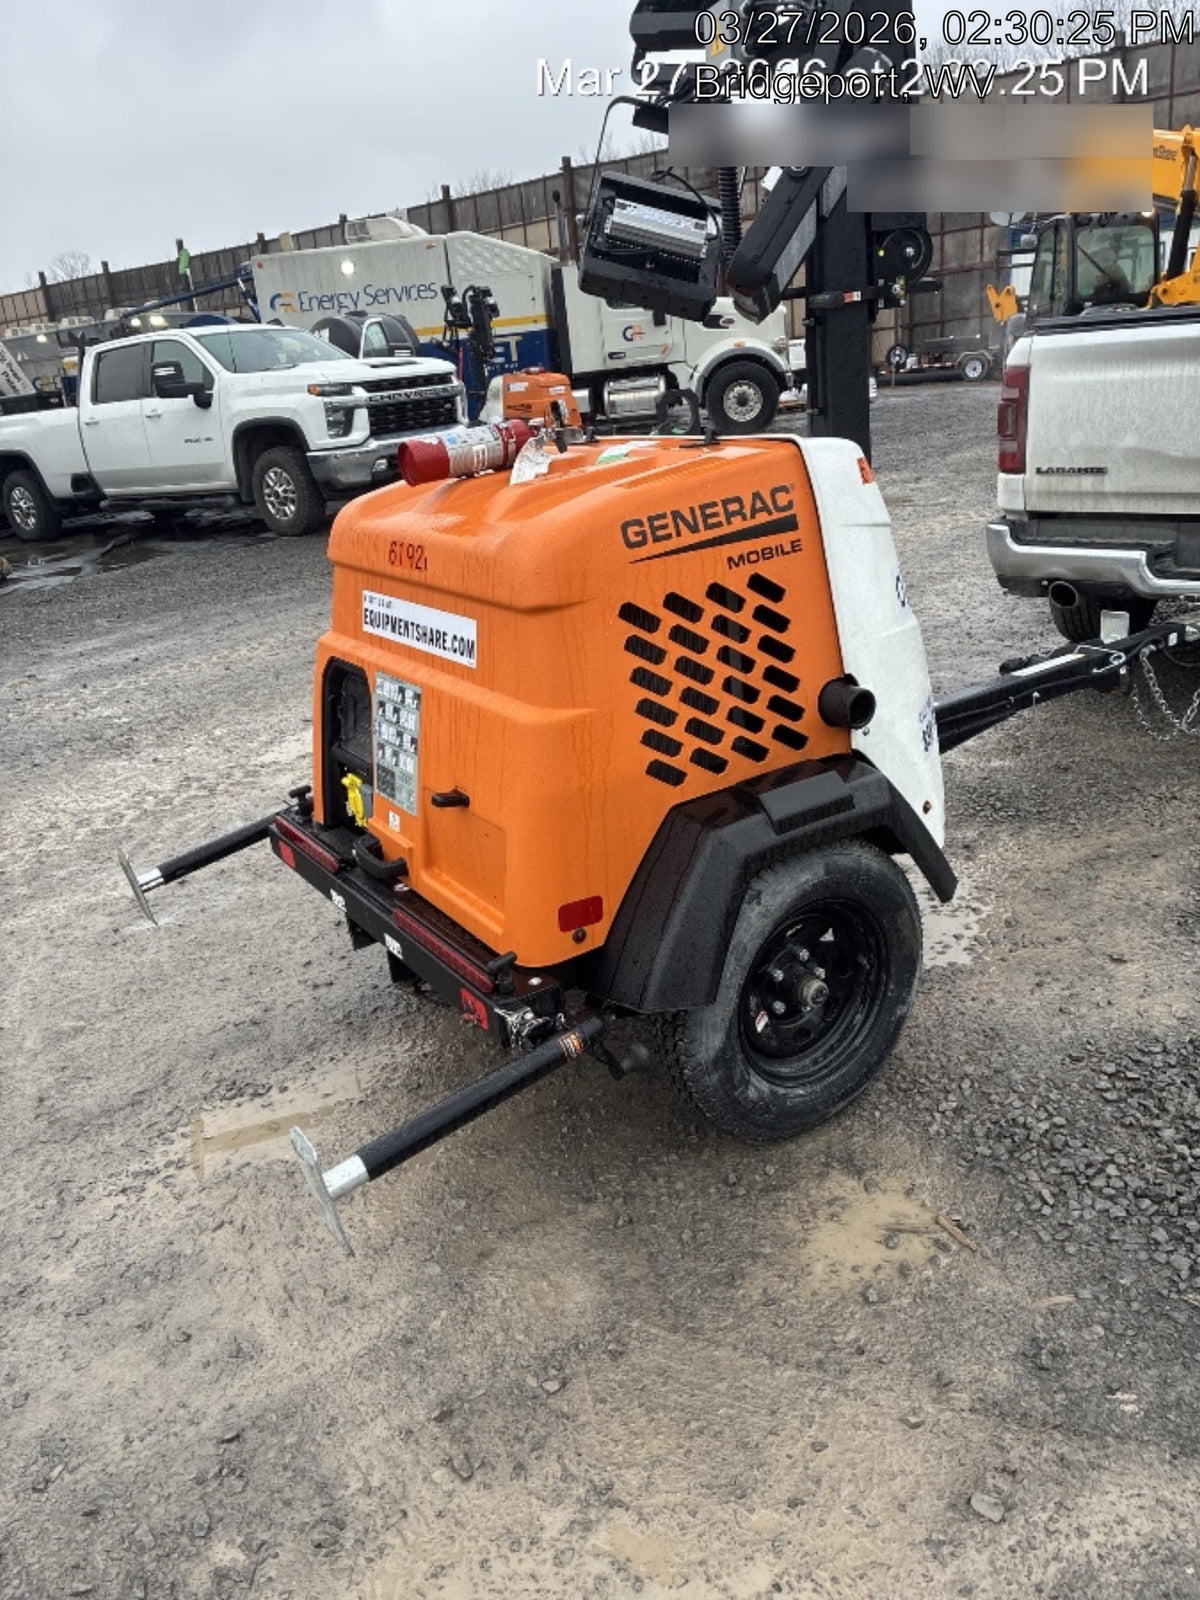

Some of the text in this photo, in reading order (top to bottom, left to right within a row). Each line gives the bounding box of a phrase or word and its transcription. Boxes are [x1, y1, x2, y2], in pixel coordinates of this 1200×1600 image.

[298, 291, 360, 313] Energy
[364, 282, 438, 306] Services
[620, 485, 794, 549] GENERAC
[727, 538, 803, 570] MOBILE
[364, 607, 476, 660] EQUIPMENTSHARE.COM
